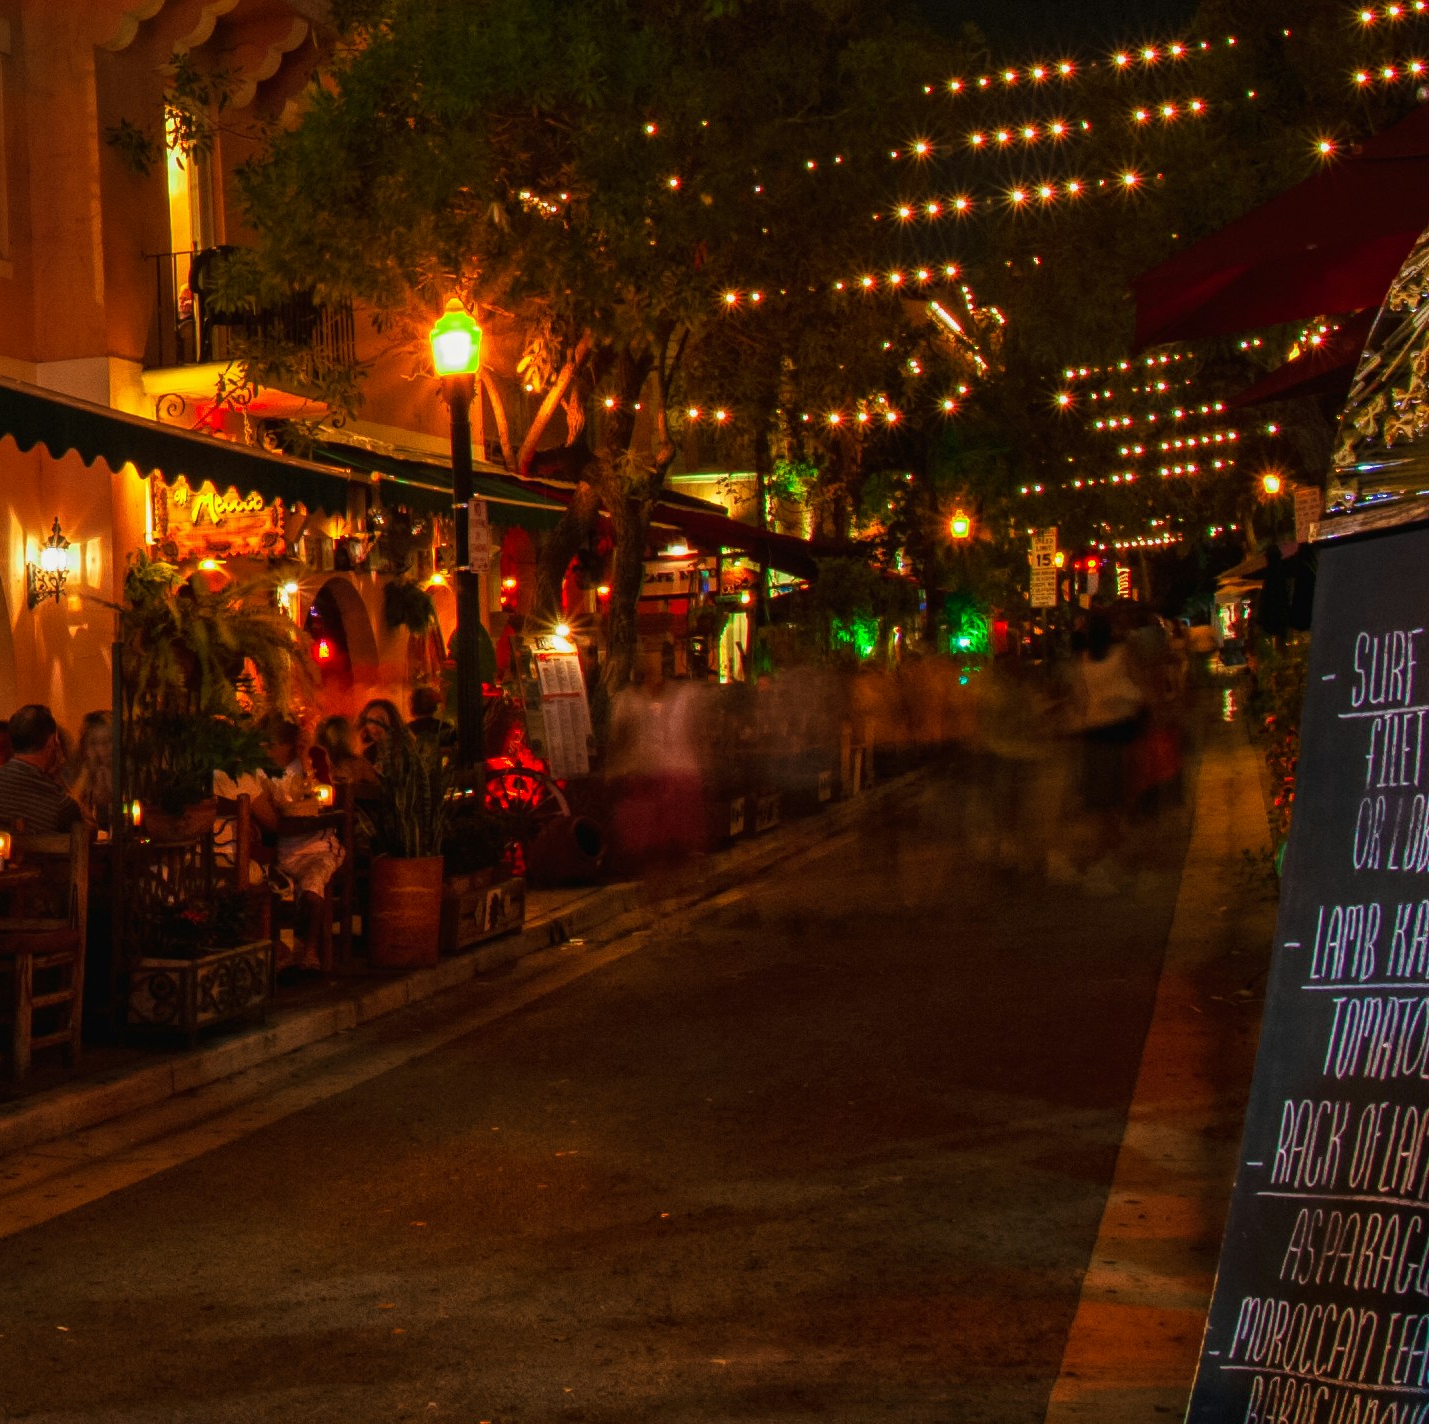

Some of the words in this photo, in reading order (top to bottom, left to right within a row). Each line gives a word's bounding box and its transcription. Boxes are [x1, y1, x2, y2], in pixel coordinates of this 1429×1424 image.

[1036, 553, 1051, 567] 15
[1351, 627, 1424, 708] SURF
[1365, 711, 1425, 789] FILET
[1353, 795, 1386, 870] OR
[1310, 902, 1381, 983] LAMB
[1386, 899, 1429, 980] KA
[1271, 1100, 1351, 1190] RACK
[1349, 1101, 1390, 1191] OF
[1229, 1296, 1379, 1383] MOROCCAN
[1378, 1312, 1429, 1386] FEA
